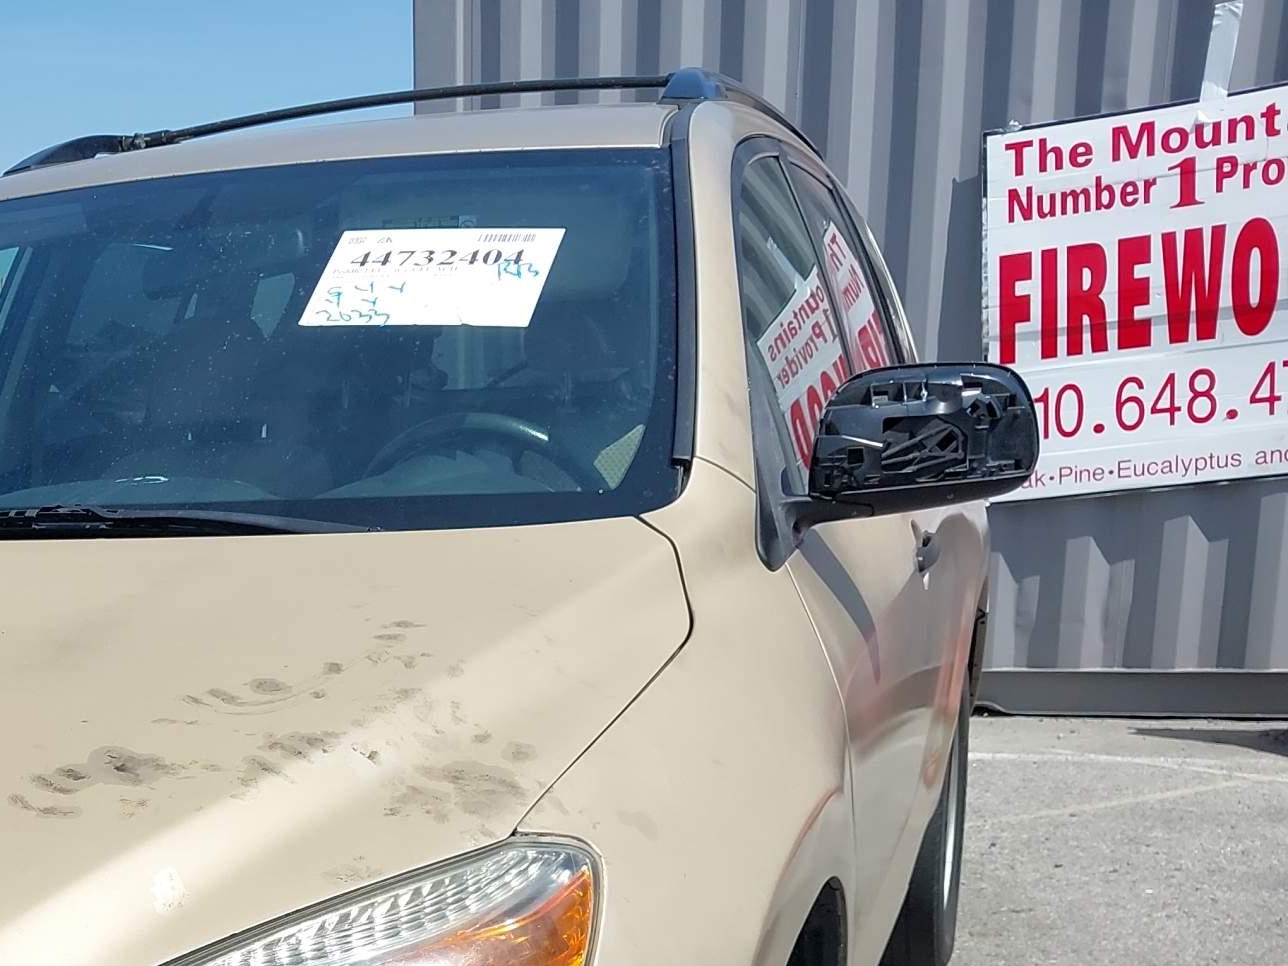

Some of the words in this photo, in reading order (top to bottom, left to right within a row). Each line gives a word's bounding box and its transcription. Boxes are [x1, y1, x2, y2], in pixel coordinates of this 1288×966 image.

[1005, 137, 1093, 177] The
[1111, 103, 1288, 162] Mount
[1007, 176, 1157, 223] Number
[1168, 156, 1205, 209] 1
[1215, 154, 1288, 193] Pro
[350, 248, 525, 268] 44732404
[999, 217, 1280, 365] FIREWO
[1034, 361, 1288, 440] 10.648.4
